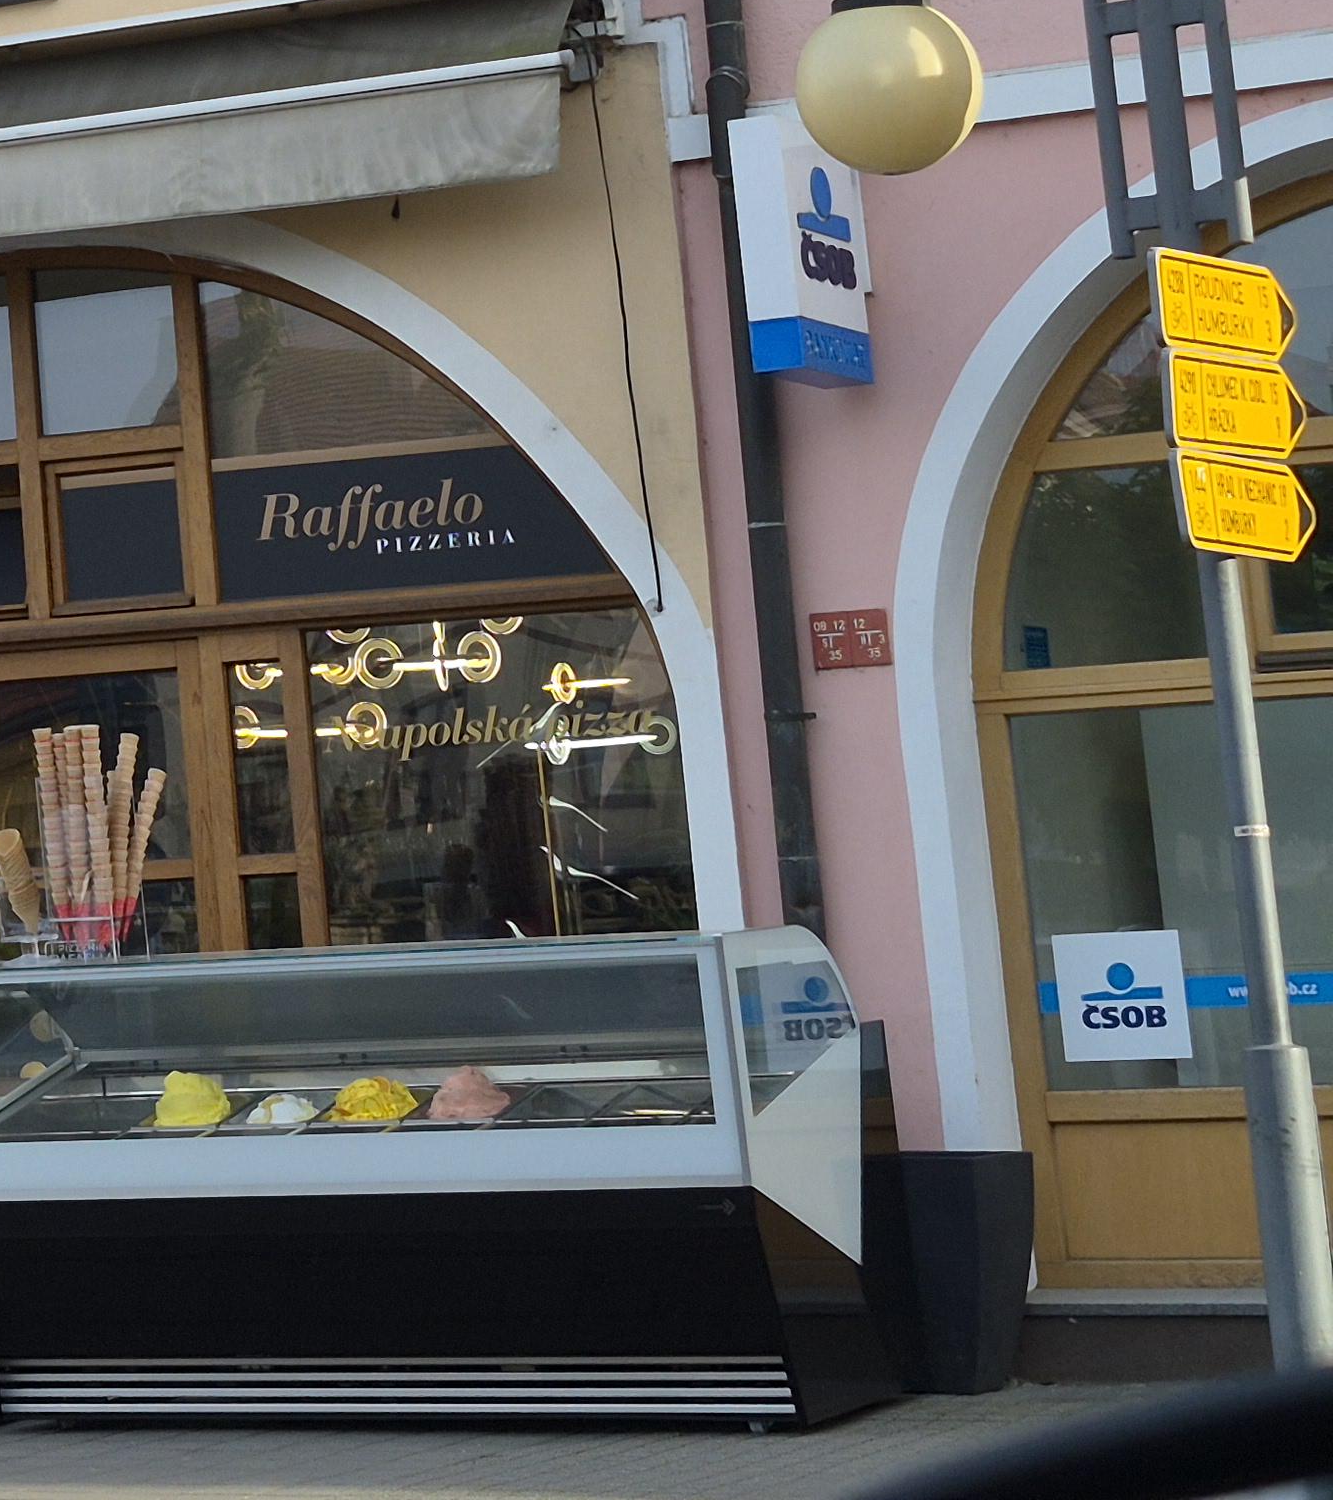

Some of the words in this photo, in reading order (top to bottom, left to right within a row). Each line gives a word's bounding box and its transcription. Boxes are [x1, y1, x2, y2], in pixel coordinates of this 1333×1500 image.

[1194, 273, 1244, 305] ROUDNICE
[1257, 285, 1269, 308] 15
[1197, 308, 1254, 339] HUMBURKY
[256, 478, 483, 551] Raffaelo
[375, 528, 515, 554] PIZZERIA
[1228, 981, 1318, 998] wwb.cz
[1081, 1004, 1168, 1030] ČSOB
